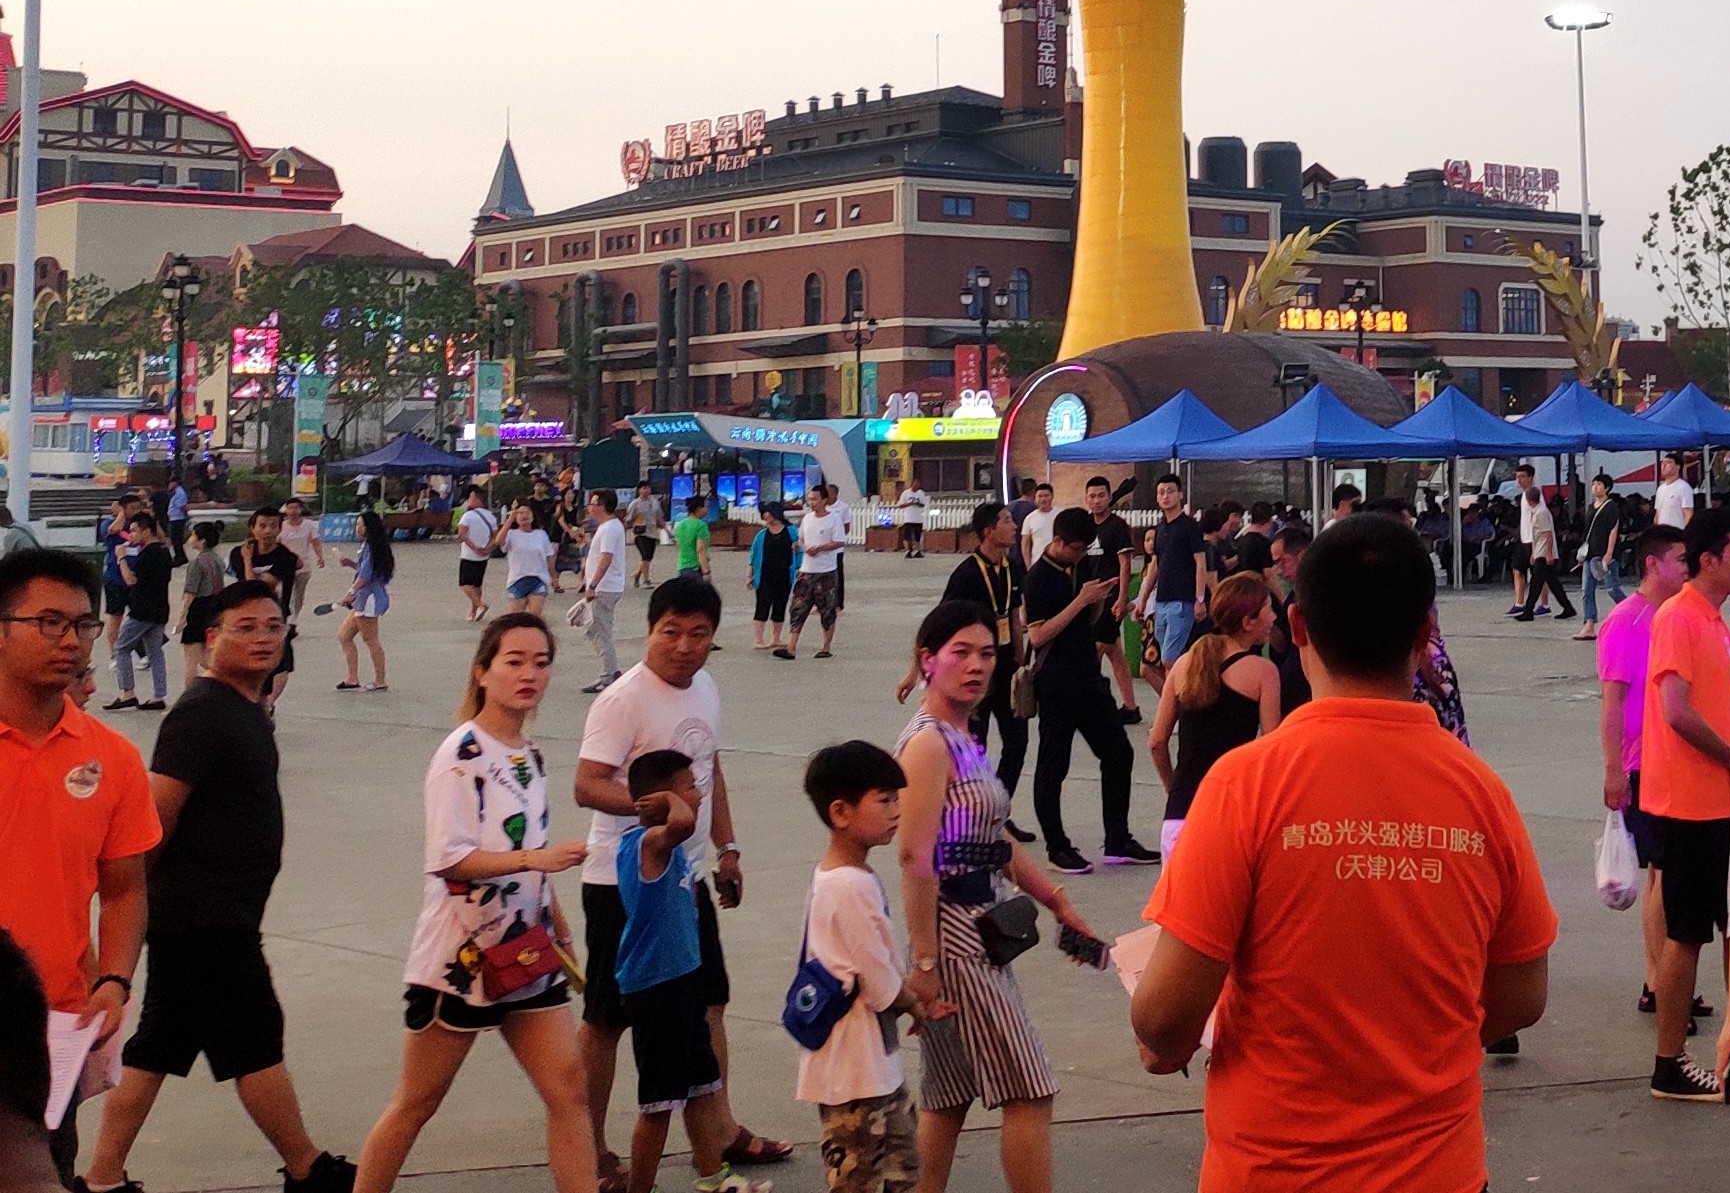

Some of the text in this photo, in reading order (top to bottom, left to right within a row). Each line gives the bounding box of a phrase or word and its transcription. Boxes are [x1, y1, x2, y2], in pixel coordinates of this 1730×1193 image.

[664, 108, 766, 161] 精酿金啤
[1281, 818, 1486, 857] 青岛光头强港口服务
[1335, 854, 1443, 884] (天津)公司
